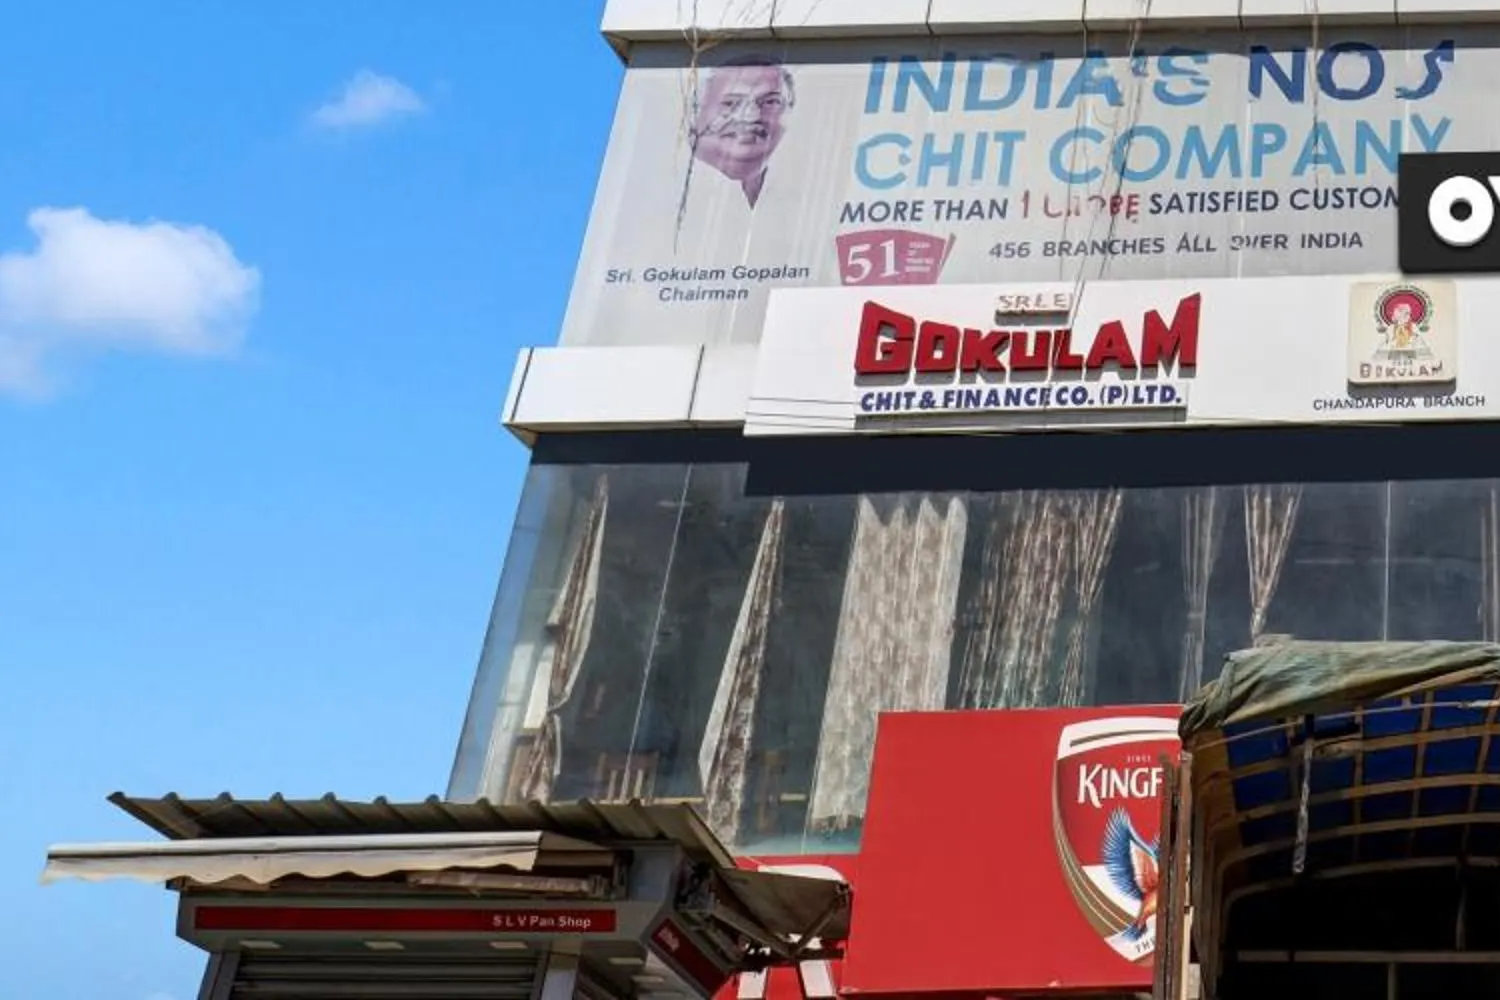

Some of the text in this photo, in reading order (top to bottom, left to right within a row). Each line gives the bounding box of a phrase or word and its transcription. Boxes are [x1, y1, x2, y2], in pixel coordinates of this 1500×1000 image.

[854, 114, 1452, 190] CHIT COMPANY
[840, 200, 923, 224] MORE
[933, 198, 1009, 221] THAN
[1148, 190, 1279, 215] SATISFIED
[989, 241, 1030, 258] 456
[1043, 237, 1165, 258] BRANCHES
[1176, 232, 1217, 253] ALL
[1301, 231, 1363, 249] INDIA
[643, 266, 726, 282] Gokulam
[731, 264, 810, 283] Gopalan
[845, 239, 899, 283] 51
[659, 286, 749, 301] Chairman
[853, 292, 1202, 377] GOKULAM
[860, 390, 915, 411] CHIT
[942, 387, 1050, 409] FINANCE
[1313, 395, 1485, 411] CHANDAPURA BRANCH
